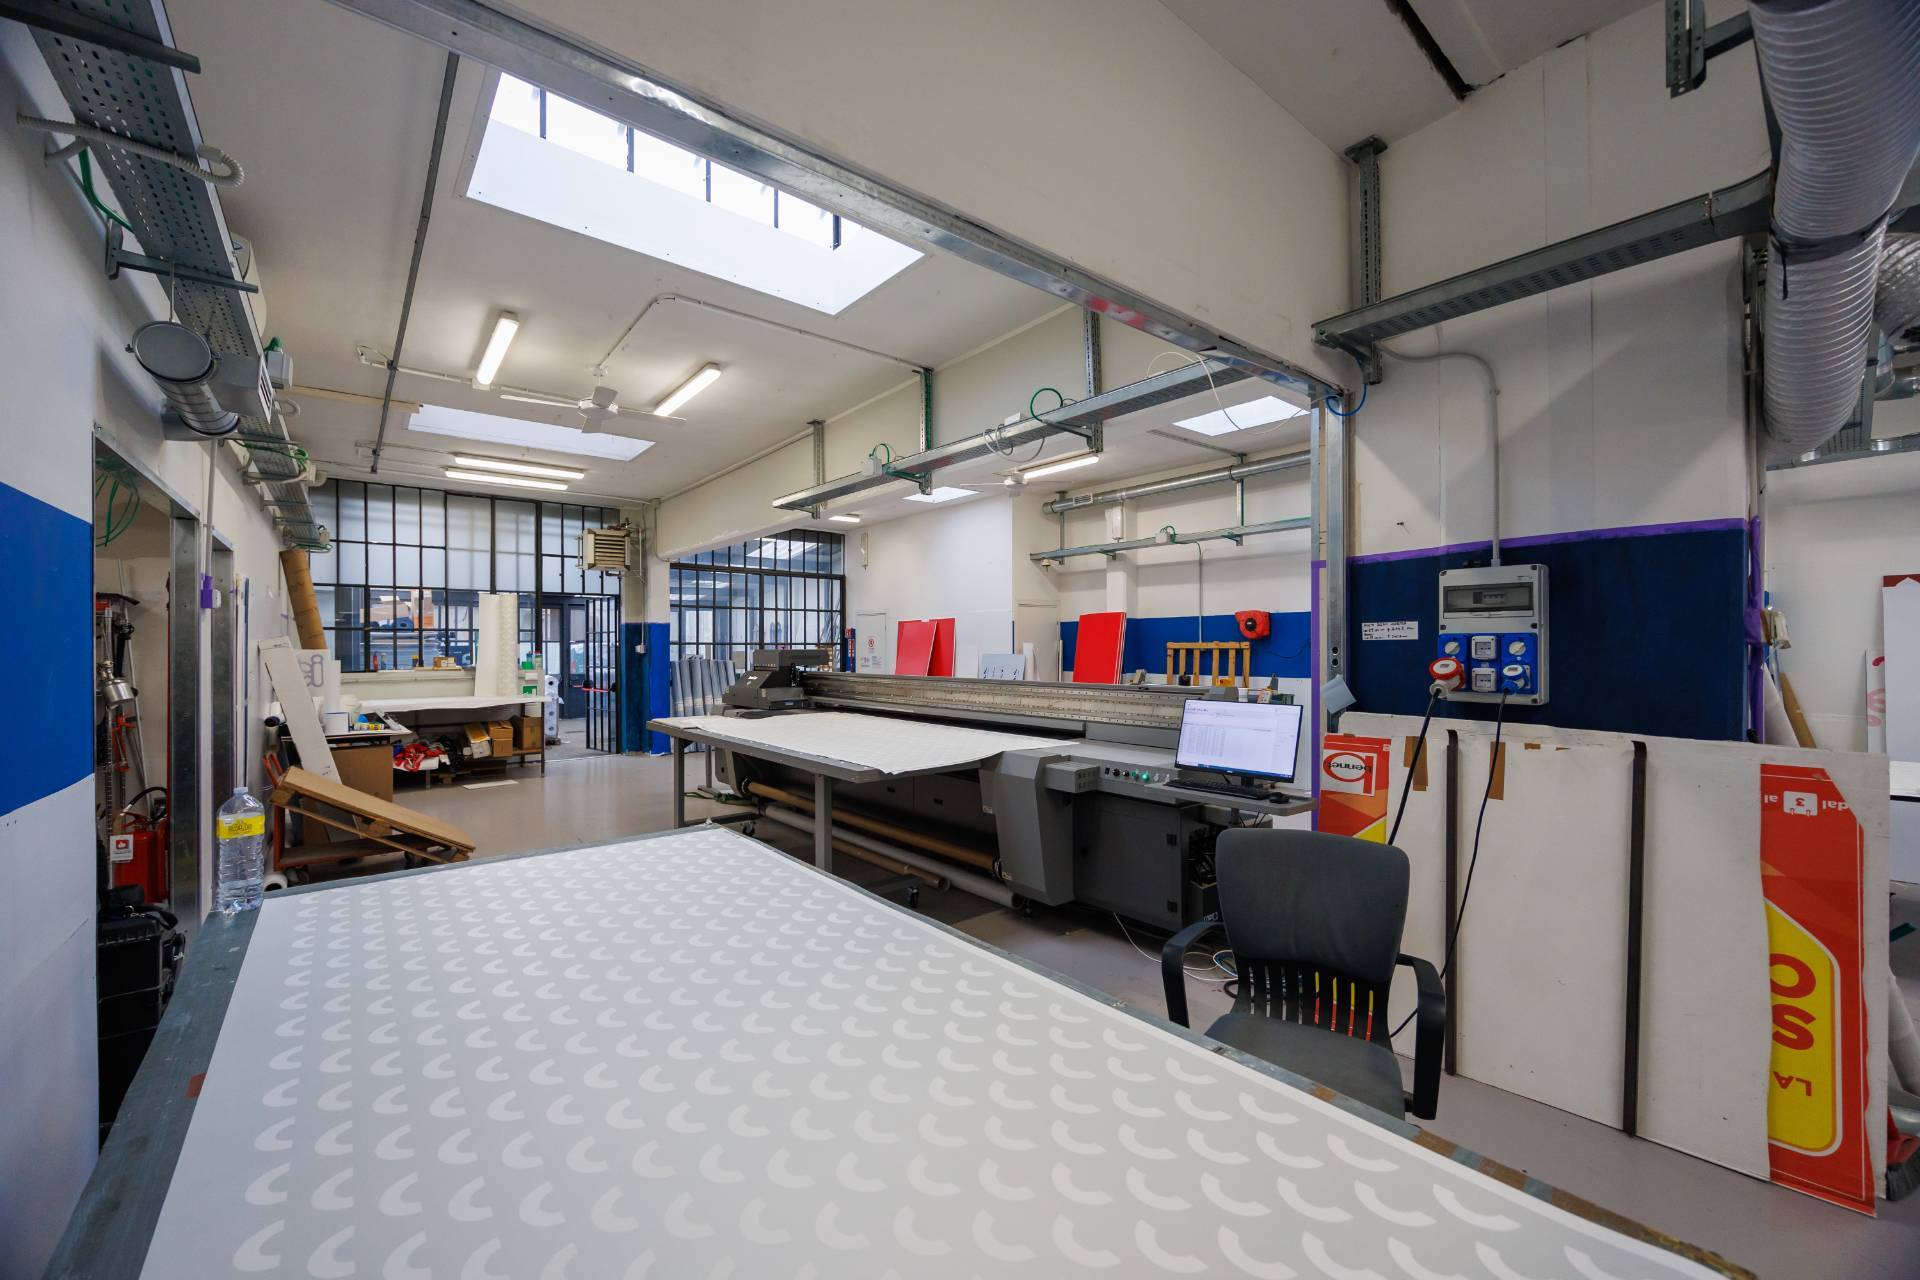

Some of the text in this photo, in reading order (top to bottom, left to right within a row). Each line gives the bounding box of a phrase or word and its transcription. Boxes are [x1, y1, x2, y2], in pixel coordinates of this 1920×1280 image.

[1763, 794, 1850, 812] dal 3 al
[1773, 1070, 1813, 1097] LA
